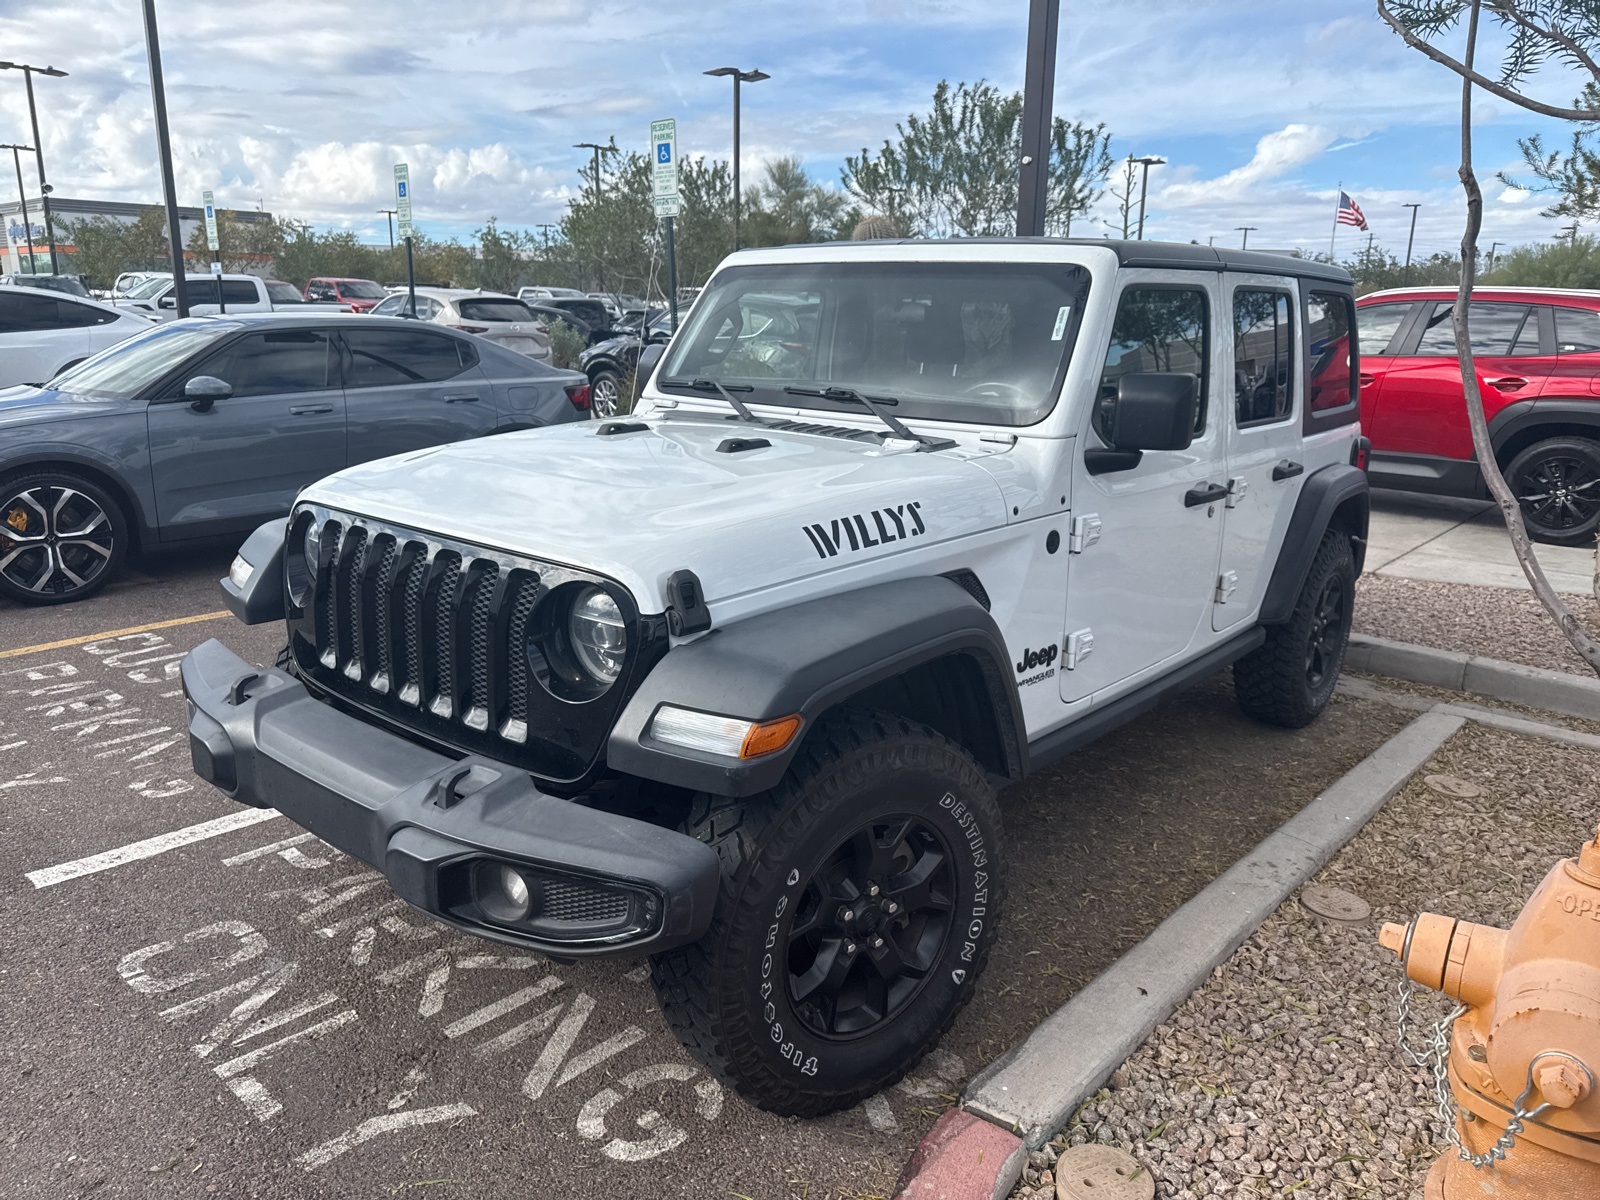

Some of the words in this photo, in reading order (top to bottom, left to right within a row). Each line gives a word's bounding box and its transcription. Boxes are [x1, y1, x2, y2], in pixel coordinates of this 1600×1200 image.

[652, 122, 674, 132] RESERVED
[653, 132, 673, 142] PARKING
[802, 501, 925, 559] WILLYS
[1016, 643, 1058, 673] Jeep
[1016, 668, 1055, 687] WRANGLER
[938, 791, 989, 962] DESTINATION
[116, 919, 478, 1171] ONLY
